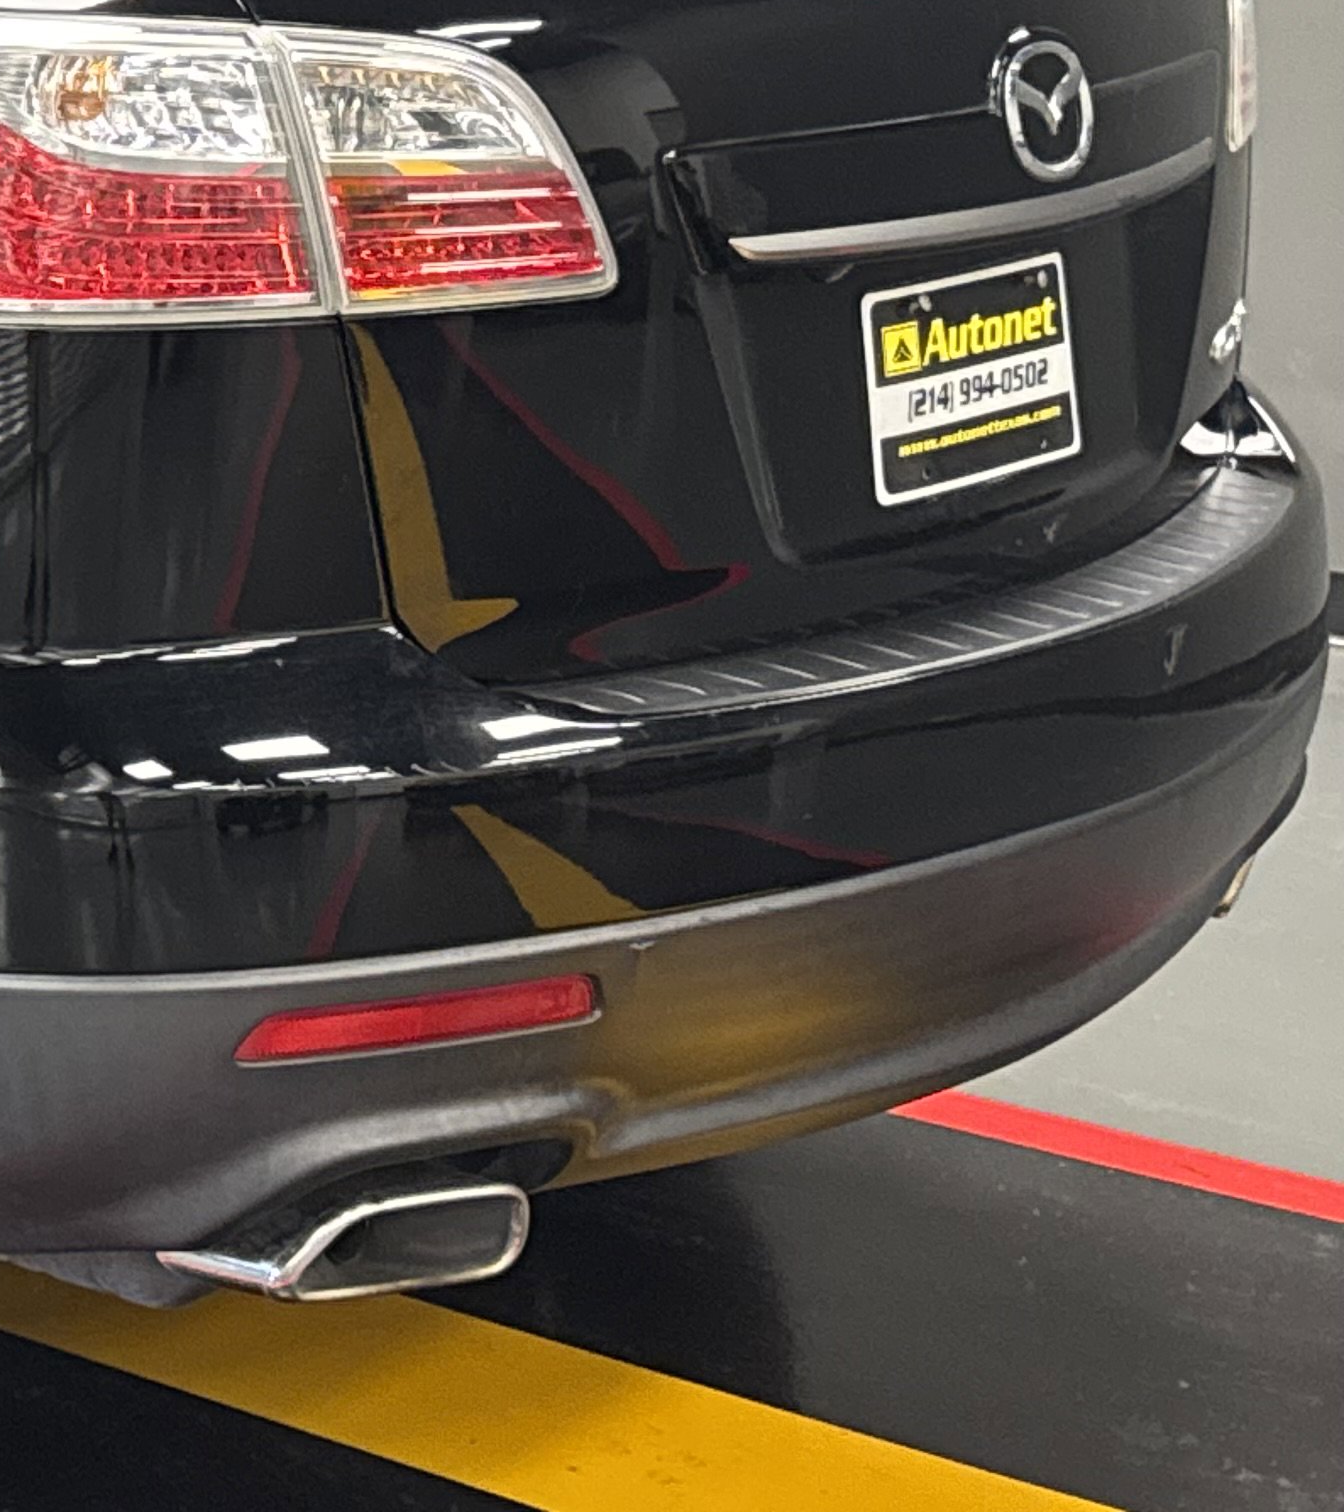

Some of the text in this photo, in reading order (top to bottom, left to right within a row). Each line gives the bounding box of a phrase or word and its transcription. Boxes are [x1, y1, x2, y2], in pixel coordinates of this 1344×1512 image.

[922, 296, 1057, 367] Autonet
[907, 357, 1049, 423] (214) 994-0502
